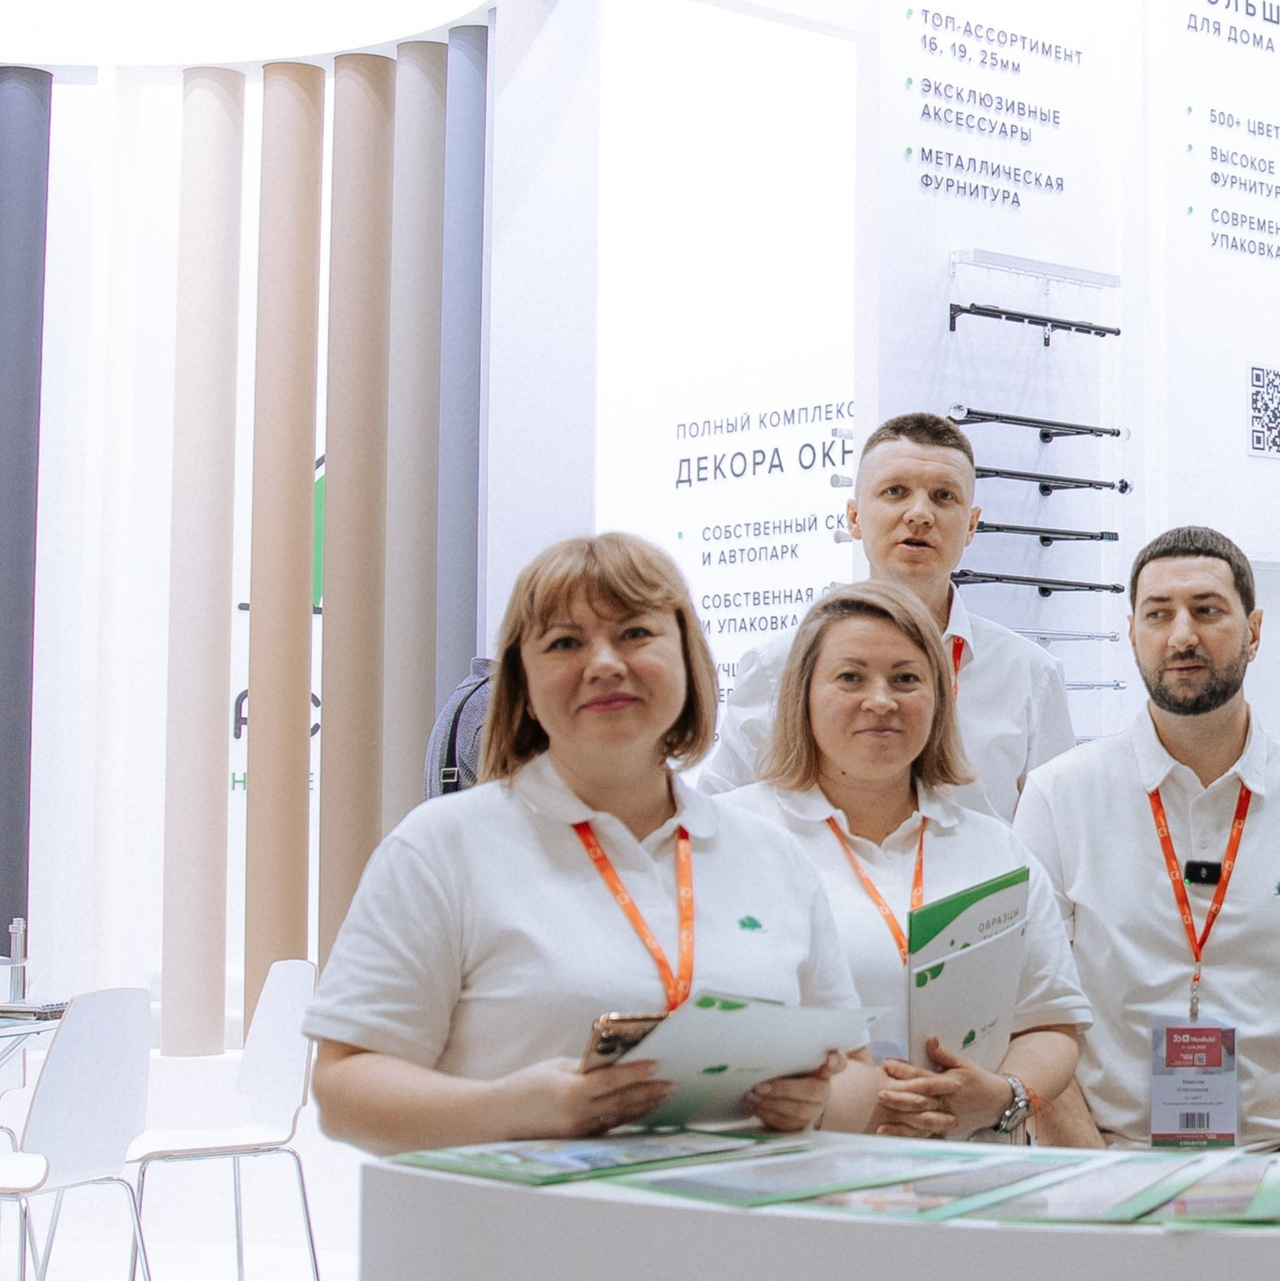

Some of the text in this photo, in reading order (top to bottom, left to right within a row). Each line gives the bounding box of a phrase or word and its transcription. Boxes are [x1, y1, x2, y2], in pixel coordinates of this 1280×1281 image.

[921, 9, 1083, 65] ТОП-АССОРТИМЕНТ
[1187, 13, 1221, 36] ДЛЯ
[1227, 25, 1275, 53] ДОМА
[980, 49, 1021, 74] 25мм
[921, 78, 1060, 125] ЭКСКЛЮЗИВНЫЕ
[921, 103, 1031, 142] АКСЕССУАРЫ
[1210, 108, 1241, 128] 500+
[921, 147, 1064, 192] МЕТАЛЛИЧЕСКАЯ
[1210, 146, 1275, 175] ВЫСОКОЕ
[920, 173, 1021, 207] ФУРНИТУРА
[677, 412, 750, 440] ПОЛНЫЙ
[675, 447, 784, 489] ДЕКОРА
[702, 514, 817, 542] СОБСТВЕННЫЙ
[702, 543, 799, 566] И АВТОПАРК
[702, 587, 814, 610] СОБСТВЕННАЯ
[701, 614, 798, 636] И УПАКОВКА
[978, 907, 1020, 932] ОБРАЗЦЫ
